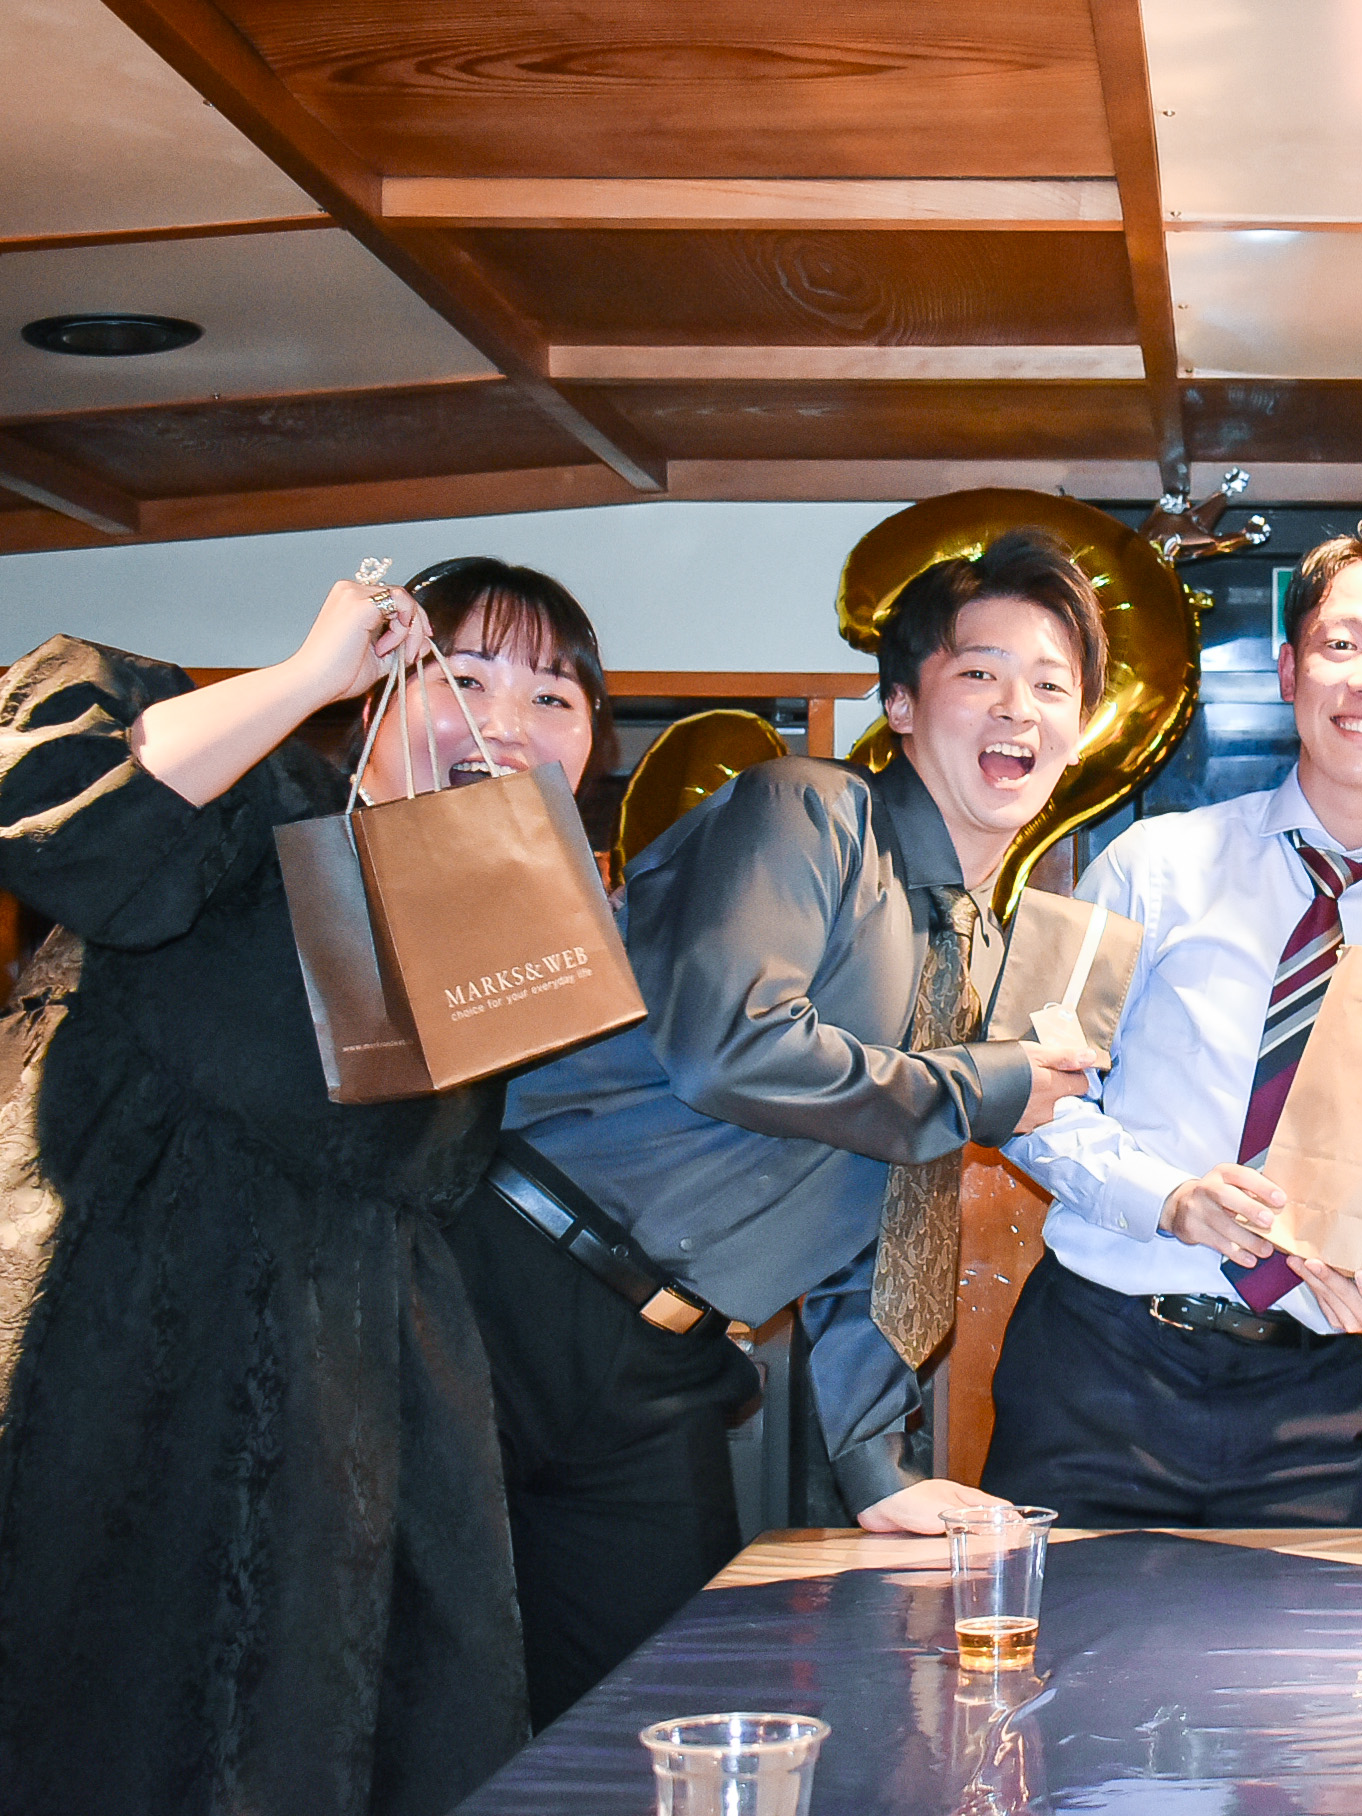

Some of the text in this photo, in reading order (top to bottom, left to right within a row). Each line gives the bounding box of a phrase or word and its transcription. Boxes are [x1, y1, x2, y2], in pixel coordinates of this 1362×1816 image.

[444, 947, 588, 1008] MARKS&WEB
[451, 967, 593, 1022] choice for your everyday life
